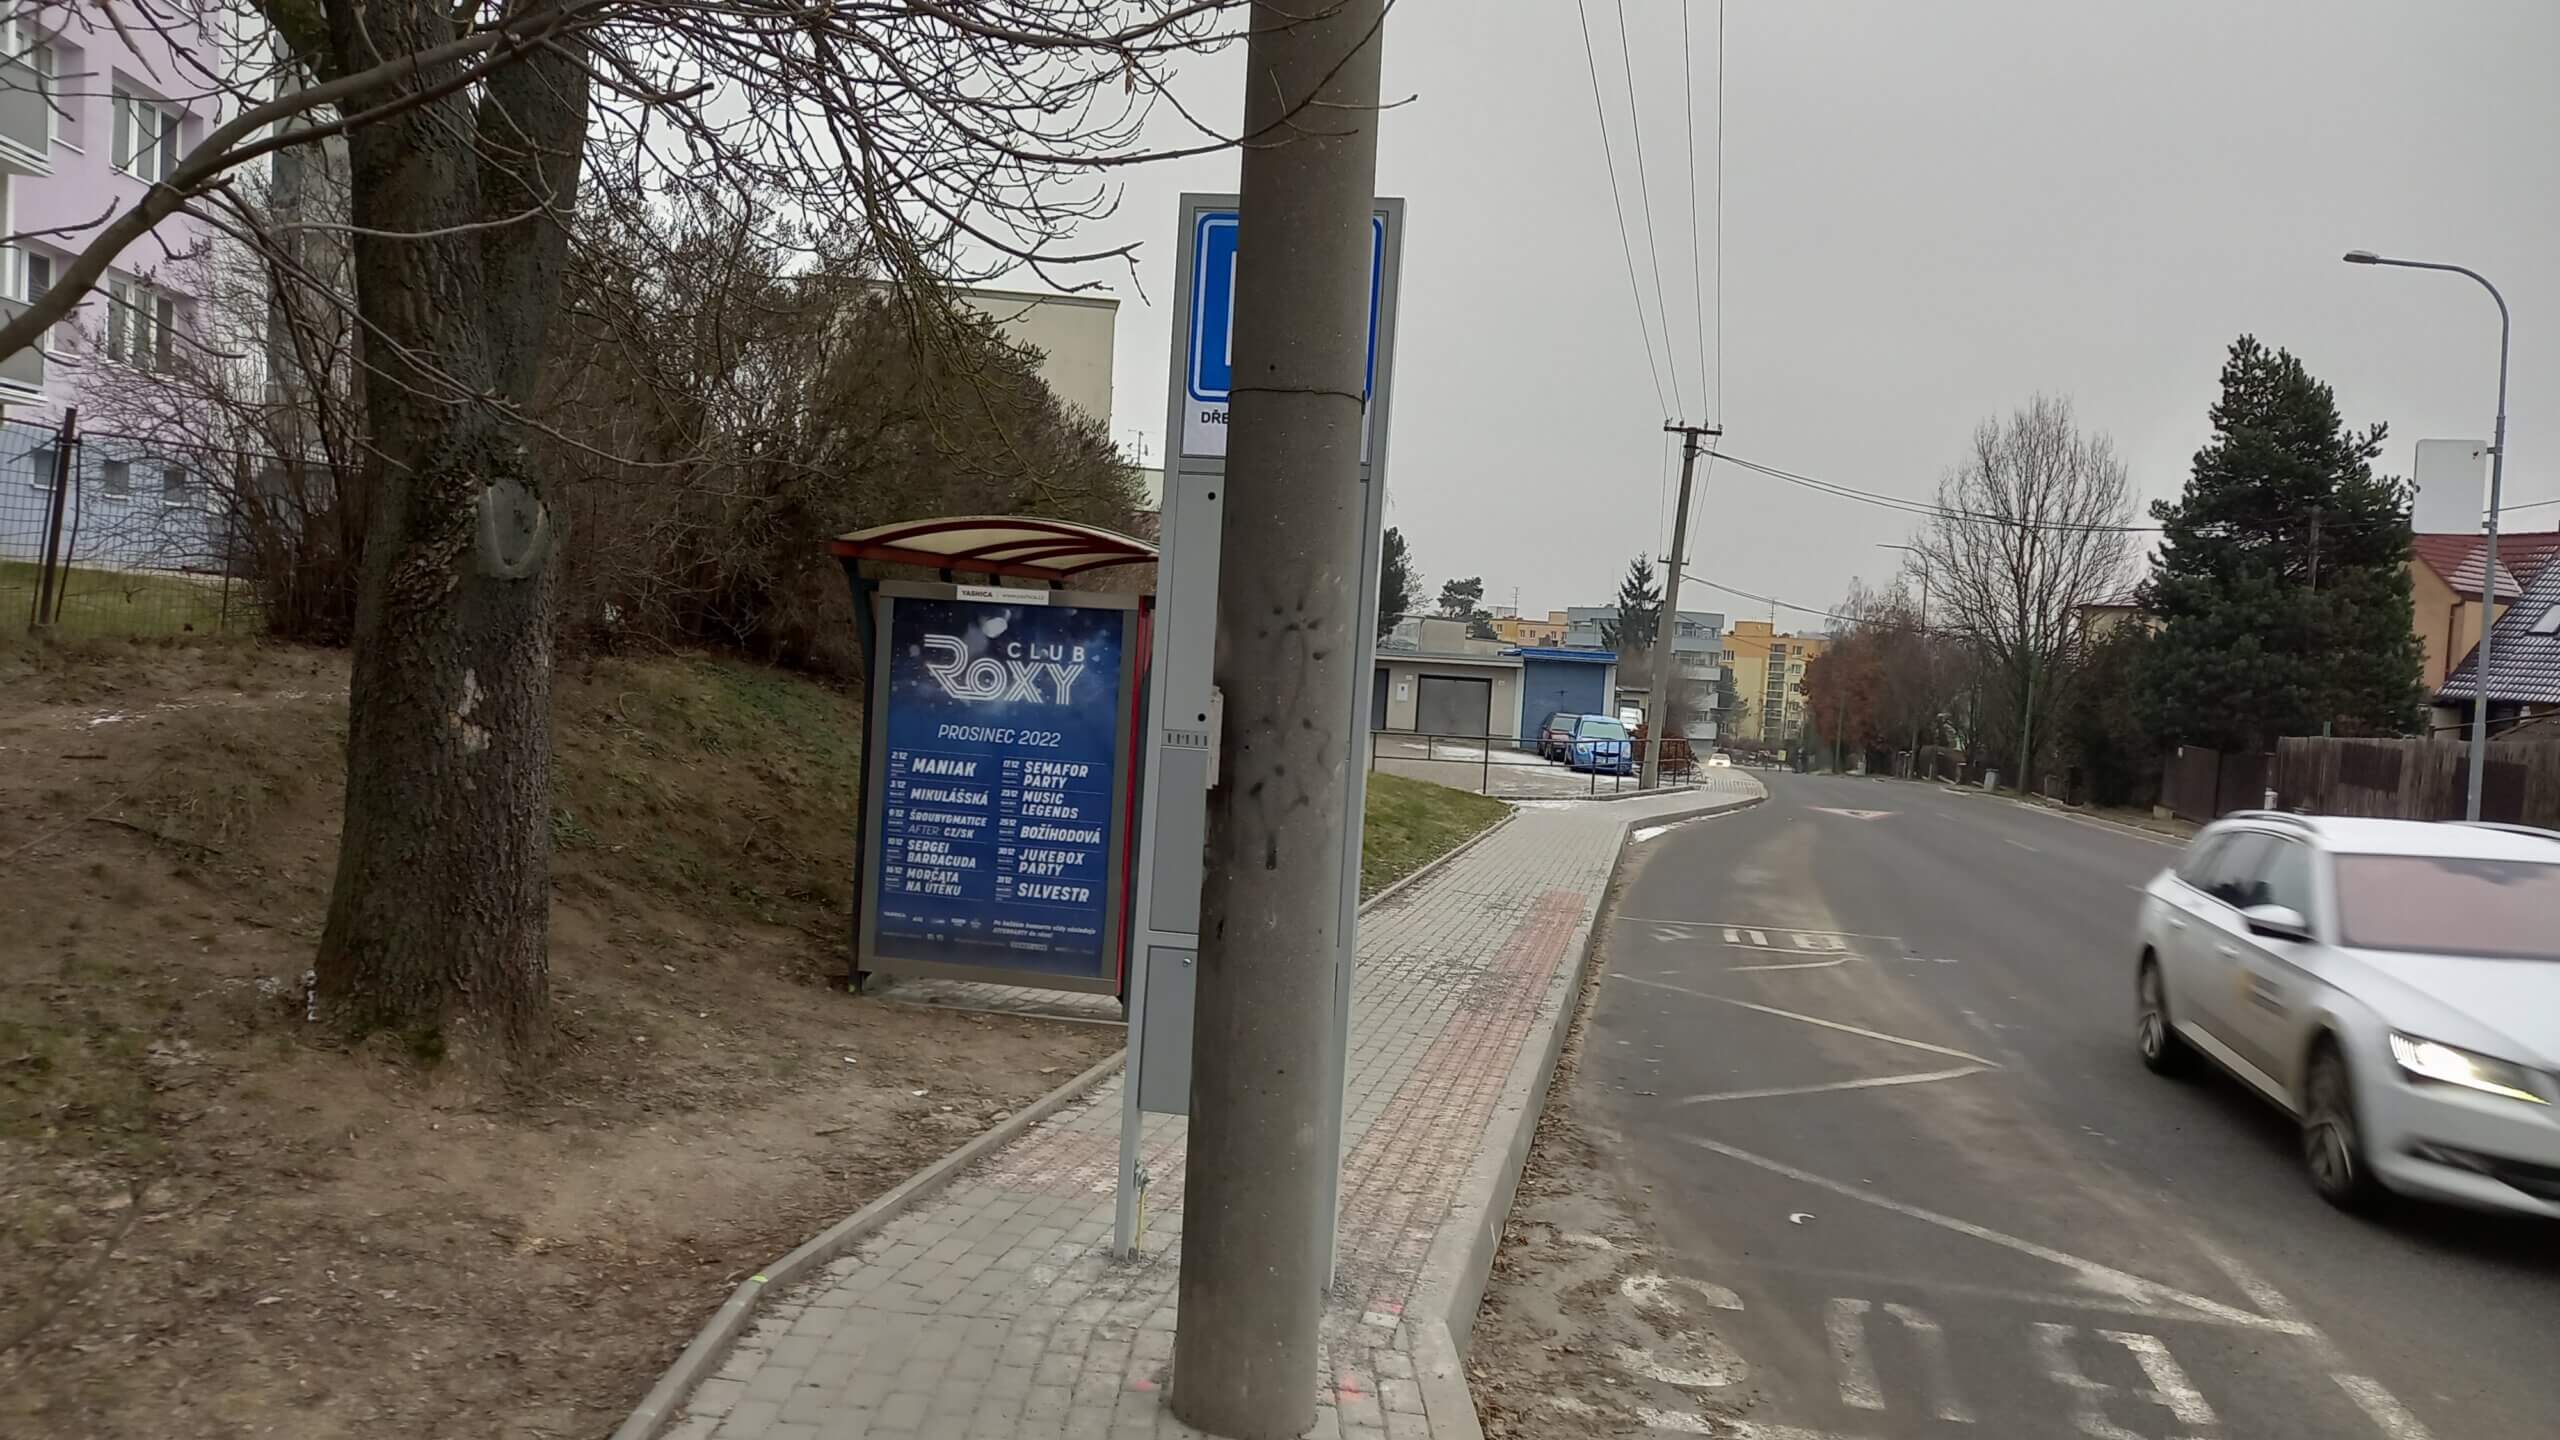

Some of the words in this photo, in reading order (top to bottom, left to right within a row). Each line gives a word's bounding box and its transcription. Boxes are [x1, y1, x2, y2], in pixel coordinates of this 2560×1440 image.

[962, 590, 993, 598] YASHICA
[1007, 642, 1085, 662] CLUB
[924, 634, 1085, 705] ROXY
[938, 724, 1016, 744] PROSINEC
[1018, 730, 1062, 747] 2022
[912, 758, 977, 777] MANIAK
[1024, 761, 1088, 778] SEMAFOR
[1023, 775, 1068, 789] PARTY
[910, 788, 989, 806] MIKULÁŠSKÁ
[1022, 790, 1064, 805] MUSIC
[1021, 804, 1079, 819] LEGENDS
[1020, 824, 1101, 844] BOŽÍHODOVÁ
[907, 840, 950, 854] SERGEI
[907, 852, 976, 868] BARRACUDA
[1018, 848, 1085, 865] JUKEBOX
[907, 867, 959, 883] MORČATA
[1018, 862, 1064, 877] PARTY
[906, 881, 921, 892] NA
[925, 880, 961, 896] ÚTĚKU
[1017, 883, 1090, 903] SILVESTR
